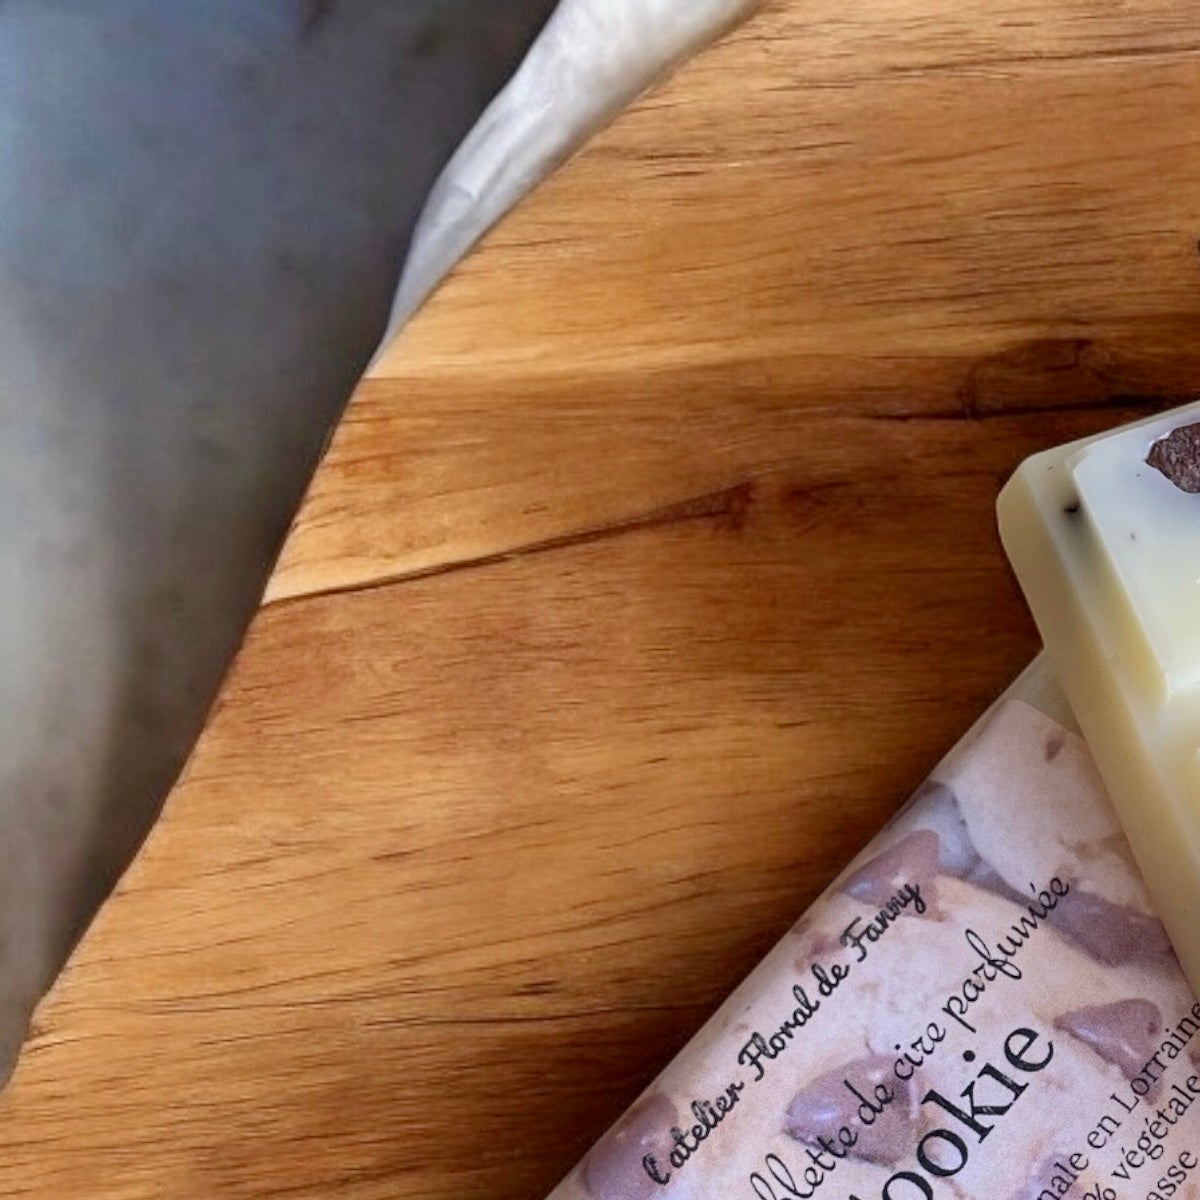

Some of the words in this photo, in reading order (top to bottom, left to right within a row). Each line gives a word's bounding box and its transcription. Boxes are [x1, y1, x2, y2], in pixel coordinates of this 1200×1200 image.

[738, 984, 820, 1082] Floral
[811, 963, 850, 997] de
[840, 883, 927, 963] Fanny
[843, 1079, 895, 1125] de
[893, 1022, 946, 1081] cire
[941, 876, 1070, 1034] parfumée
[1086, 1114, 1121, 1150] en
